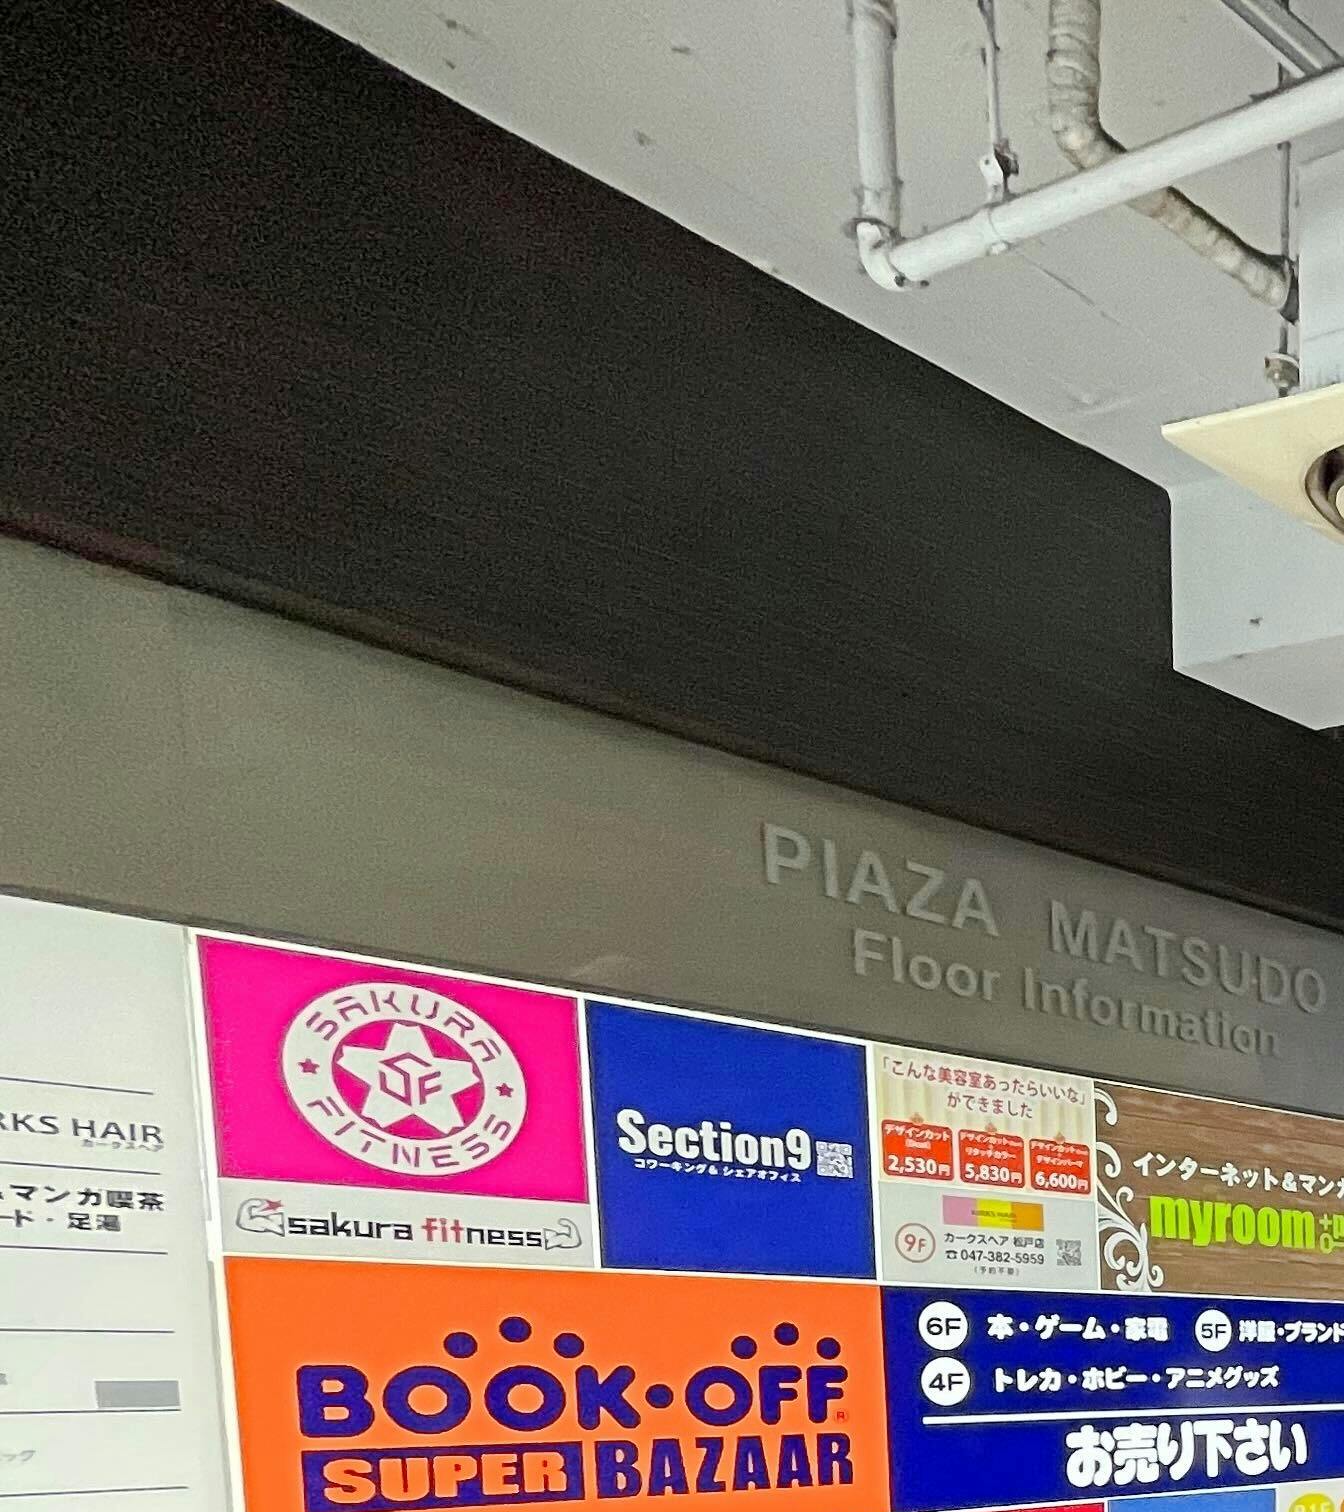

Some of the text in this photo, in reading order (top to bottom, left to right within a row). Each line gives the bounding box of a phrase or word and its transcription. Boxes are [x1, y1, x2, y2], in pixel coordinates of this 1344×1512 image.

[763, 822, 1327, 1015] PIAZA MATSUDO
[853, 929, 1281, 1058] Floor Information
[306, 991, 501, 1062] SAKURA
[947, 1092, 1033, 1118] ができました
[72, 1118, 164, 1143] HAIR
[307, 1096, 511, 1168] FITNESS
[616, 1108, 811, 1170] Section9
[888, 1155, 950, 1176] 2,530円
[965, 1163, 1022, 1184] 5,830円
[1035, 1171, 1088, 1191] 6,600円
[288, 1212, 542, 1248] sakura fitness
[1150, 1195, 1315, 1249] myroom
[904, 1233, 927, 1253] 9F
[944, 1233, 1009, 1246] カークスヘア
[960, 1249, 1045, 1265] 047-382-5959
[925, 1317, 961, 1336] 6F
[986, 1314, 1168, 1342] 本・ゲーム・家電
[1201, 1323, 1227, 1338] 5F
[928, 1366, 1280, 1392] 4F トレカ・ホビー・アニメグッズ
[1066, 1418, 1308, 1488] お売り下さい
[322, 1433, 854, 1504] SUPER BAZAAR
